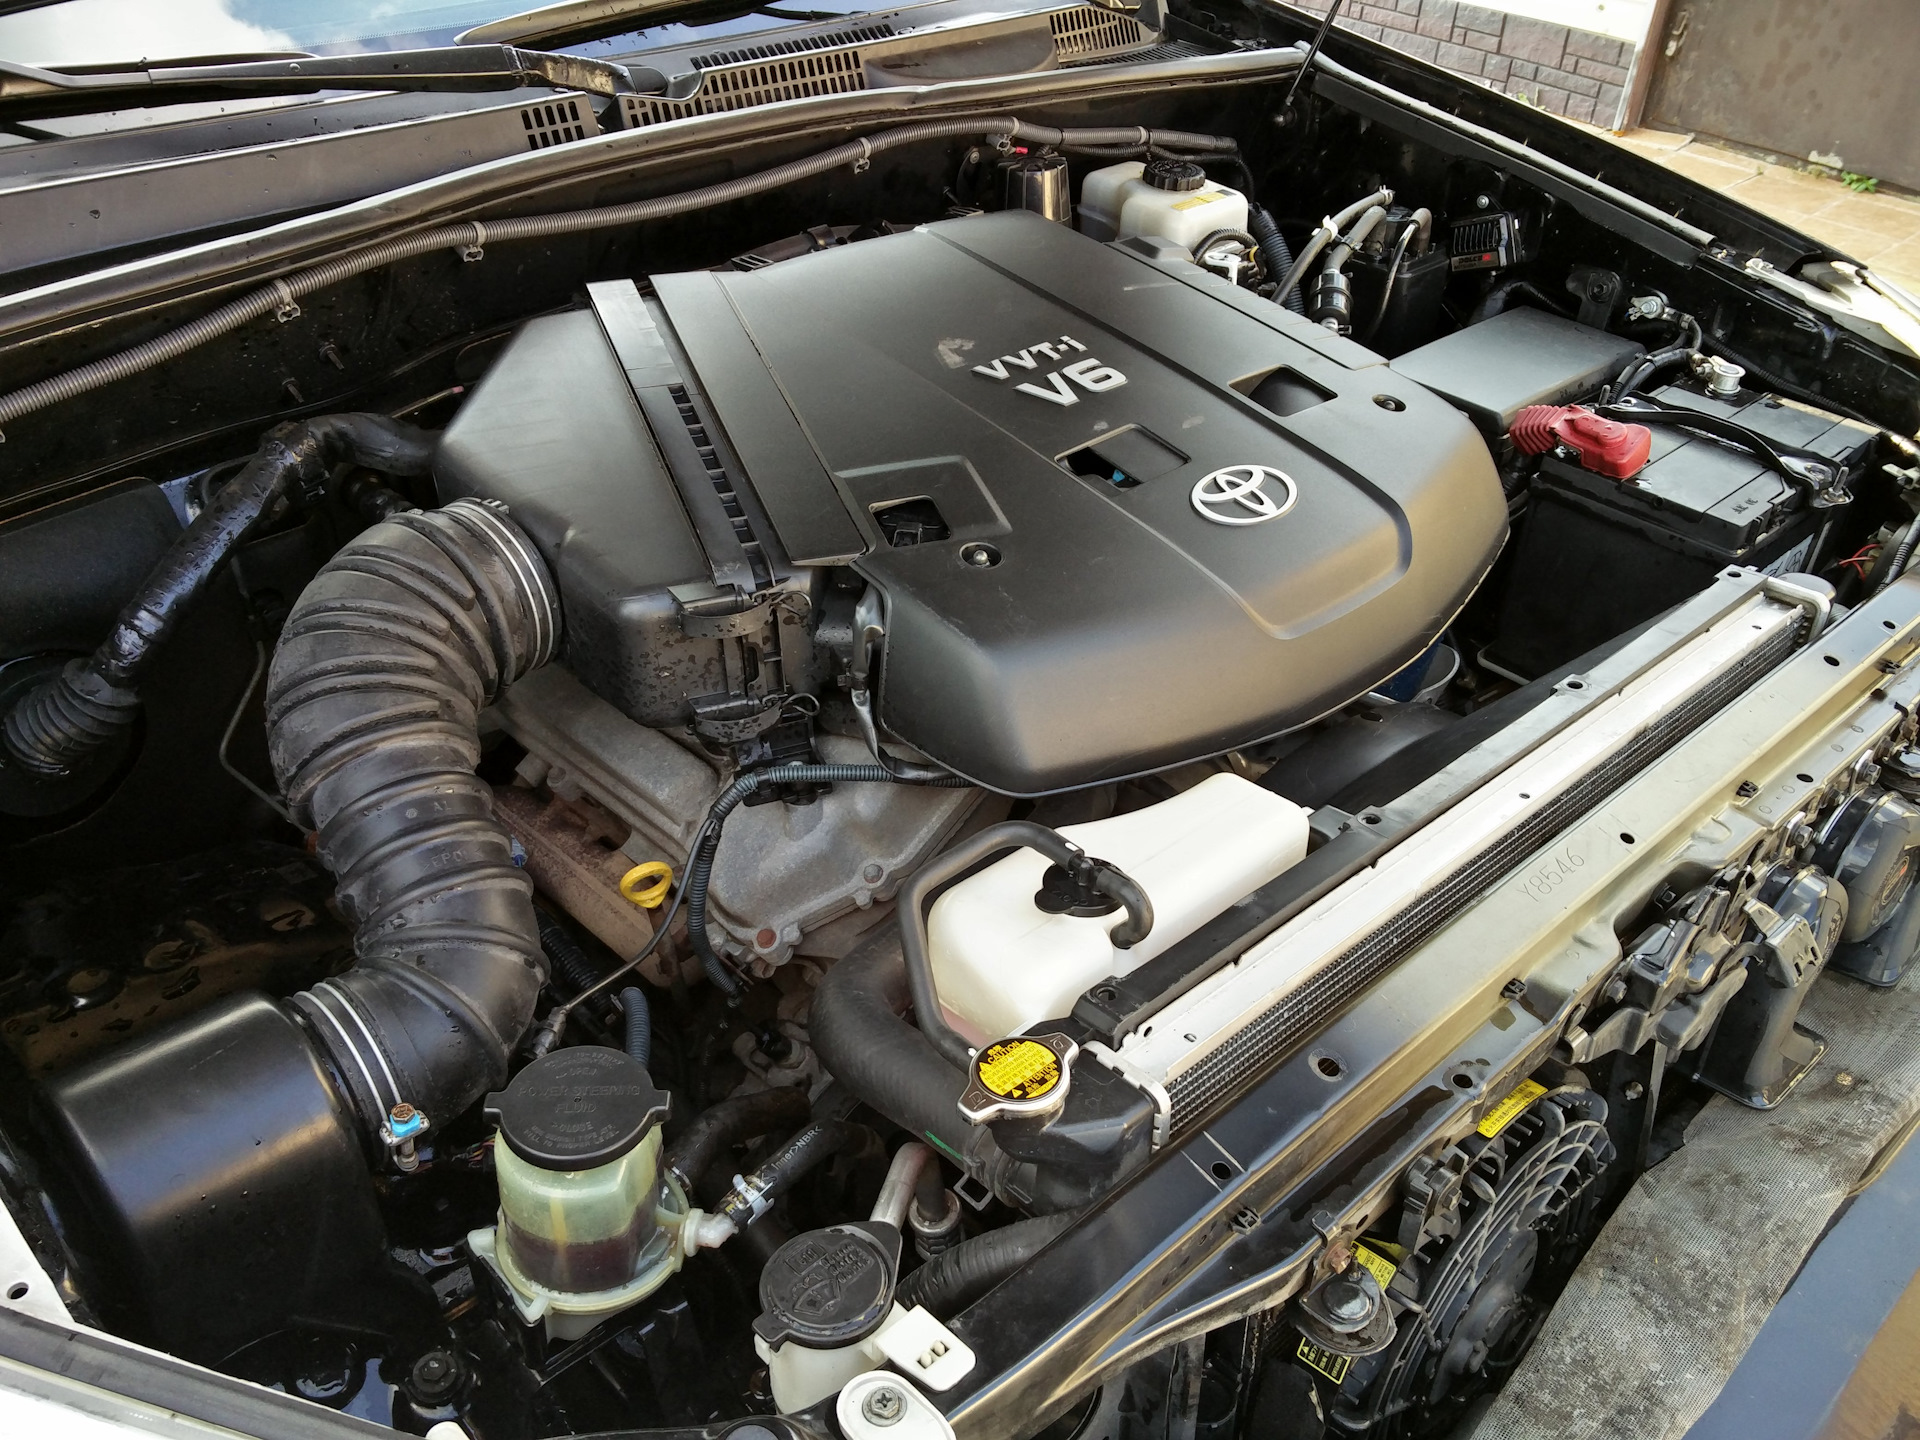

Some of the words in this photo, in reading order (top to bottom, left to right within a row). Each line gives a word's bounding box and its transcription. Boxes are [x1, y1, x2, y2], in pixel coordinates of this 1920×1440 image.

[969, 335, 1088, 380] VVT-i
[1013, 358, 1128, 408] V6
[1516, 847, 1585, 902] Y8546
[987, 1040, 1021, 1064] CAUTION
[1023, 1062, 1058, 1087] ATTENTION
[518, 1085, 568, 1097] POWER
[572, 1085, 641, 1097] STEERING
[555, 1103, 597, 1114] FLUID
